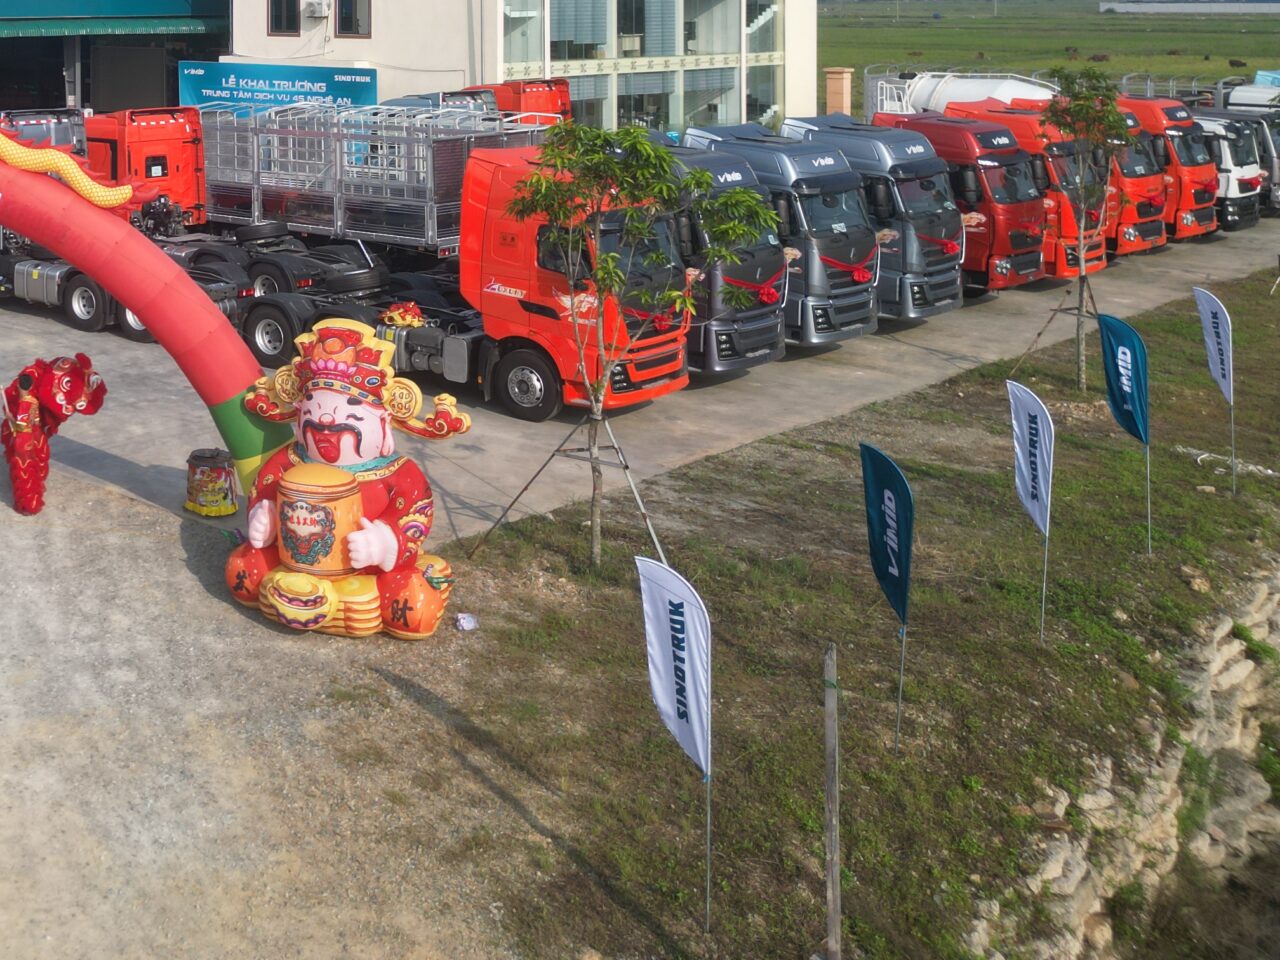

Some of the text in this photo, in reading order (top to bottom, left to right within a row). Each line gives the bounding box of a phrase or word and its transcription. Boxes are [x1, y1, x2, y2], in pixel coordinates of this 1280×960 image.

[201, 89, 231, 98] TRUNG
[232, 90, 252, 99] TÂM
[335, 97, 352, 107] AN
[239, 78, 270, 89] KHAI
[272, 80, 327, 93] TRƯƠNG
[334, 74, 371, 83] SINOTRUK
[1210, 310, 1227, 381] SINOTRUK
[1028, 411, 1039, 503] SINOTRUK
[668, 599, 688, 723] SINOTRUK
